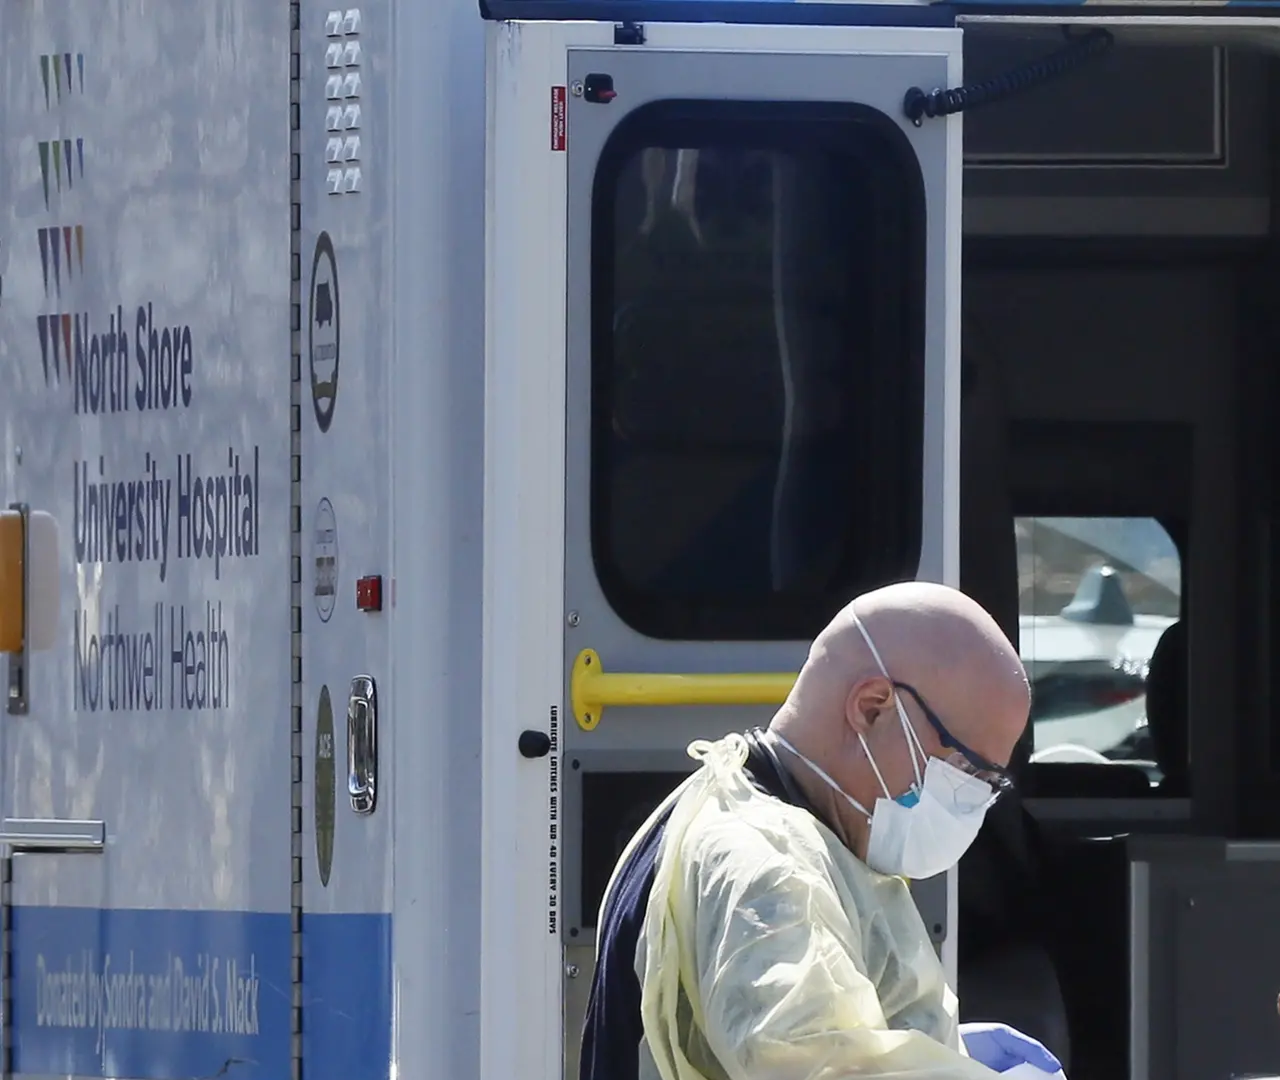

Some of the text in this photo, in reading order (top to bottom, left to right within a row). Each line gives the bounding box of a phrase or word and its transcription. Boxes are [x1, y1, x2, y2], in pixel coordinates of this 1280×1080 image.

[74, 302, 193, 414] North Shore
[74, 452, 171, 582] University
[177, 446, 259, 580] Hospital
[74, 601, 230, 712] Northwell Health
[549, 861, 557, 891] EVERY
[36, 950, 87, 1027] Donated
[87, 949, 101, 1054] by
[150, 950, 172, 1031] and
[173, 953, 209, 1032] David
[212, 957, 223, 1034] S.
[225, 953, 259, 1035] Mack
